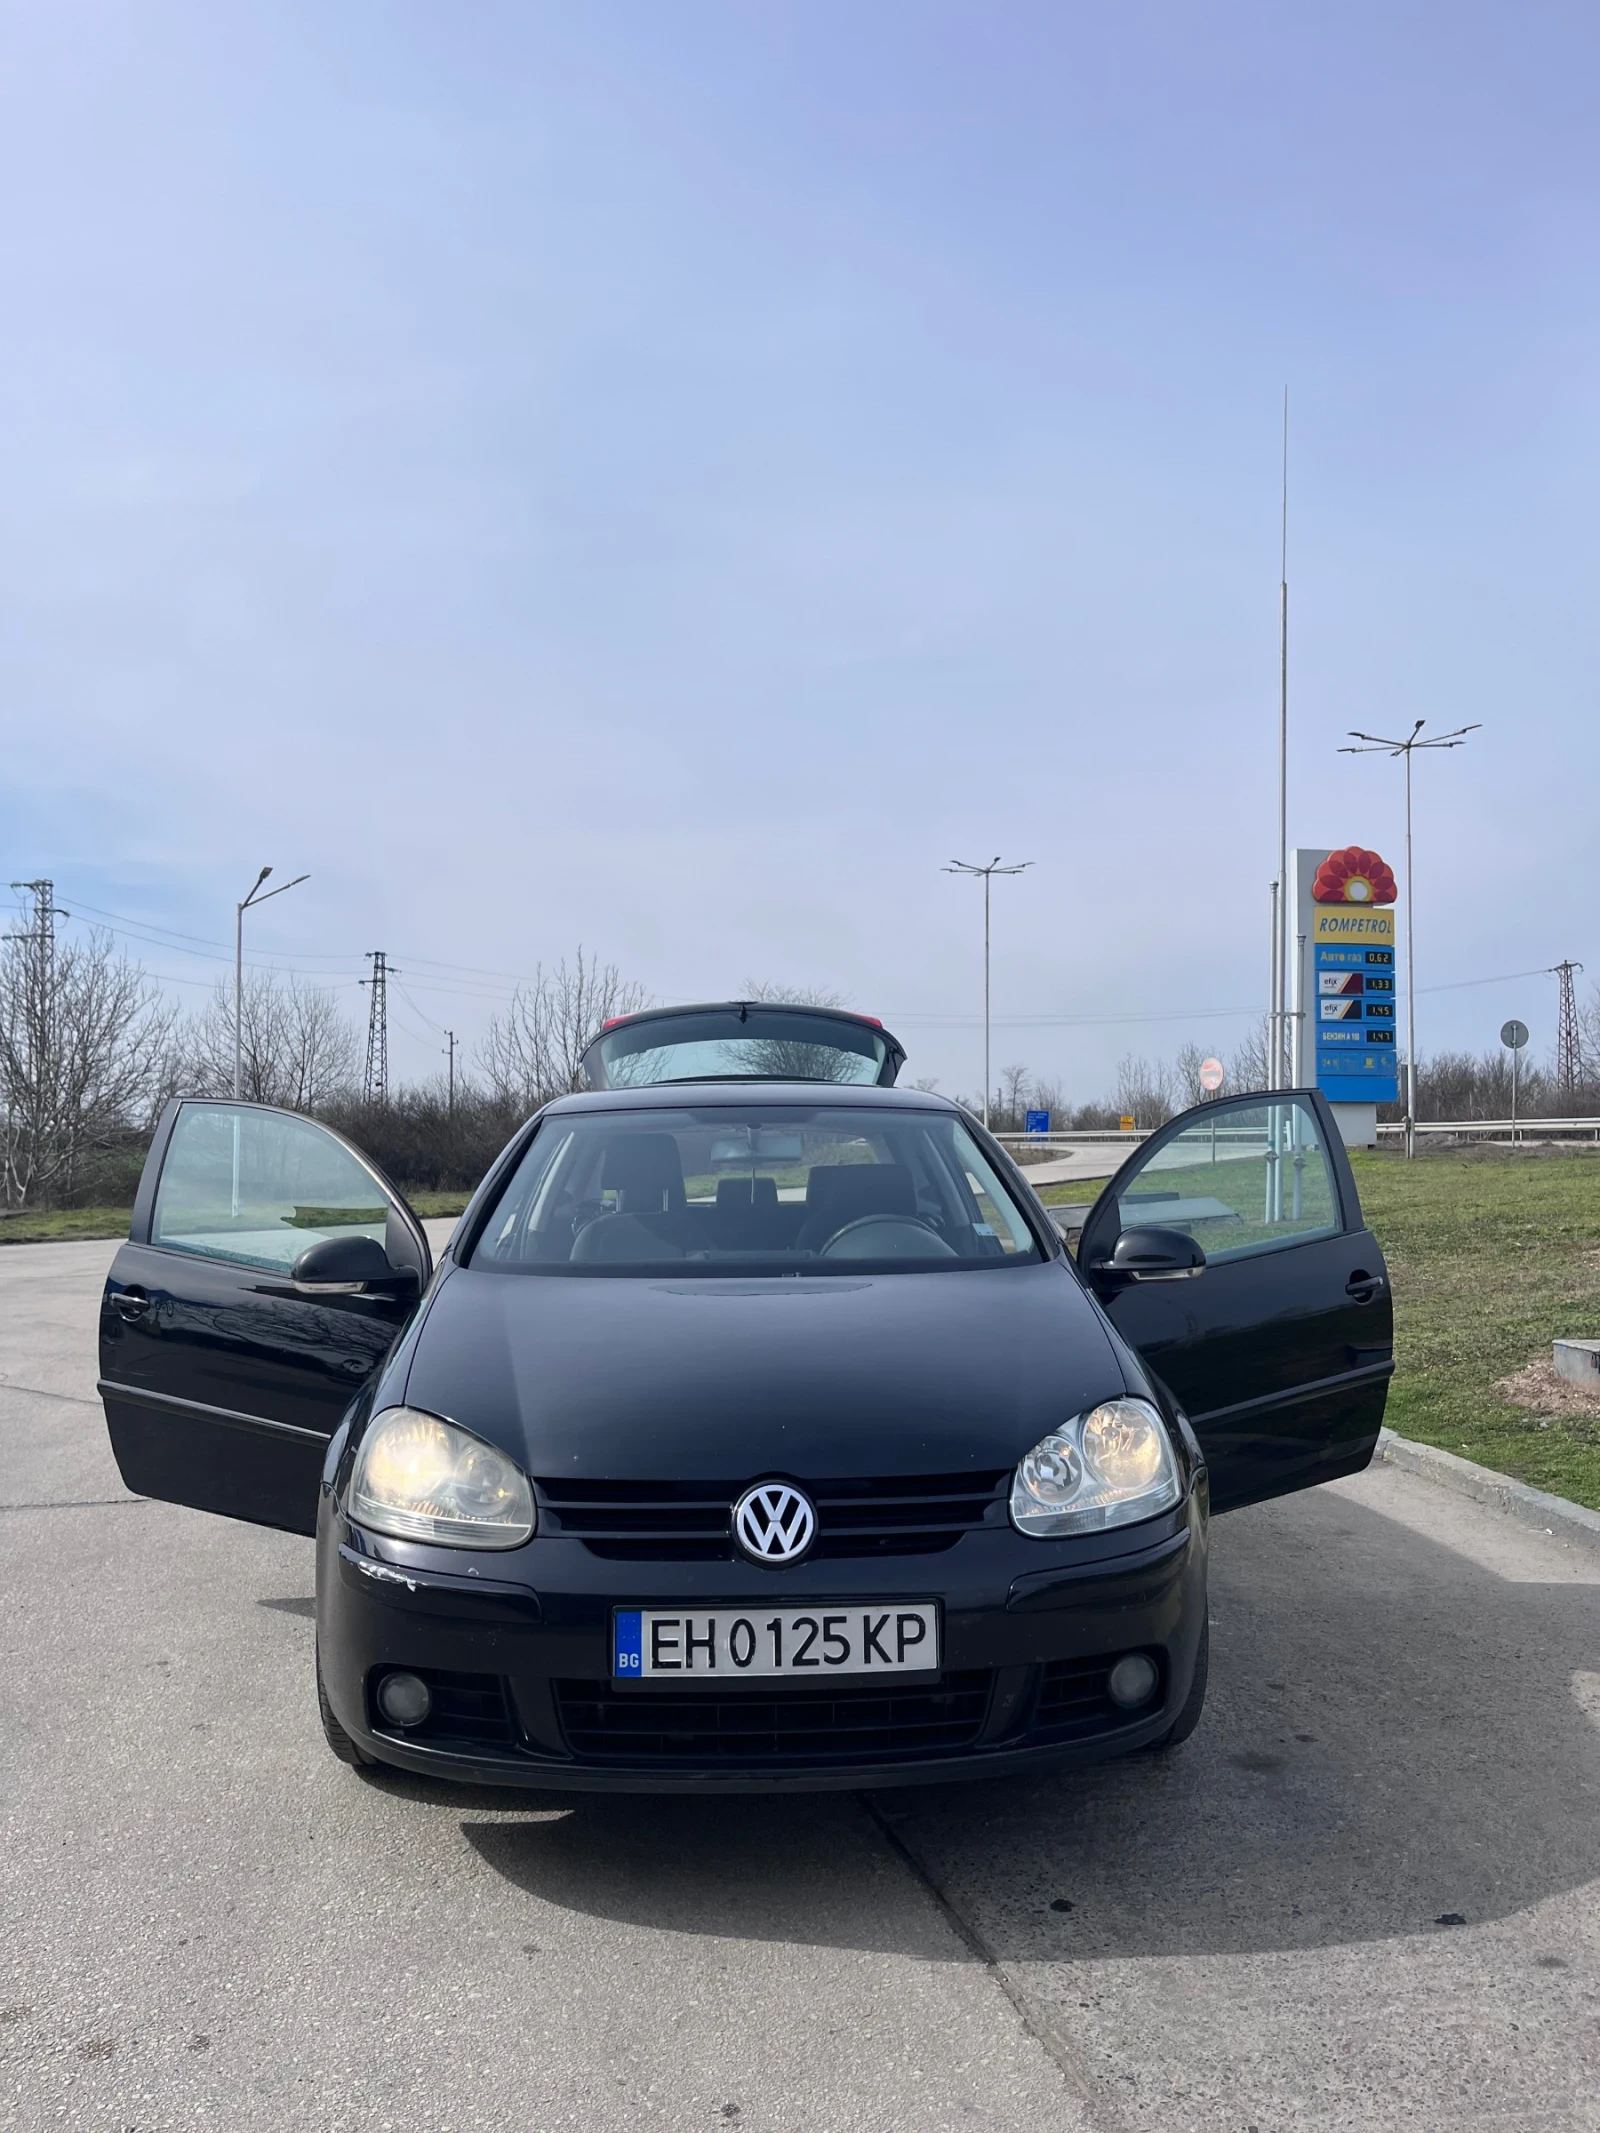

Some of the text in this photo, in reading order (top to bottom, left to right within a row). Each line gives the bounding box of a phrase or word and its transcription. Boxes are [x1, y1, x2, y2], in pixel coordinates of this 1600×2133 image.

[1319, 918, 1391, 934] ROMPETROL
[1320, 951, 1345, 962] Авто
[618, 1652, 639, 1669] BG
